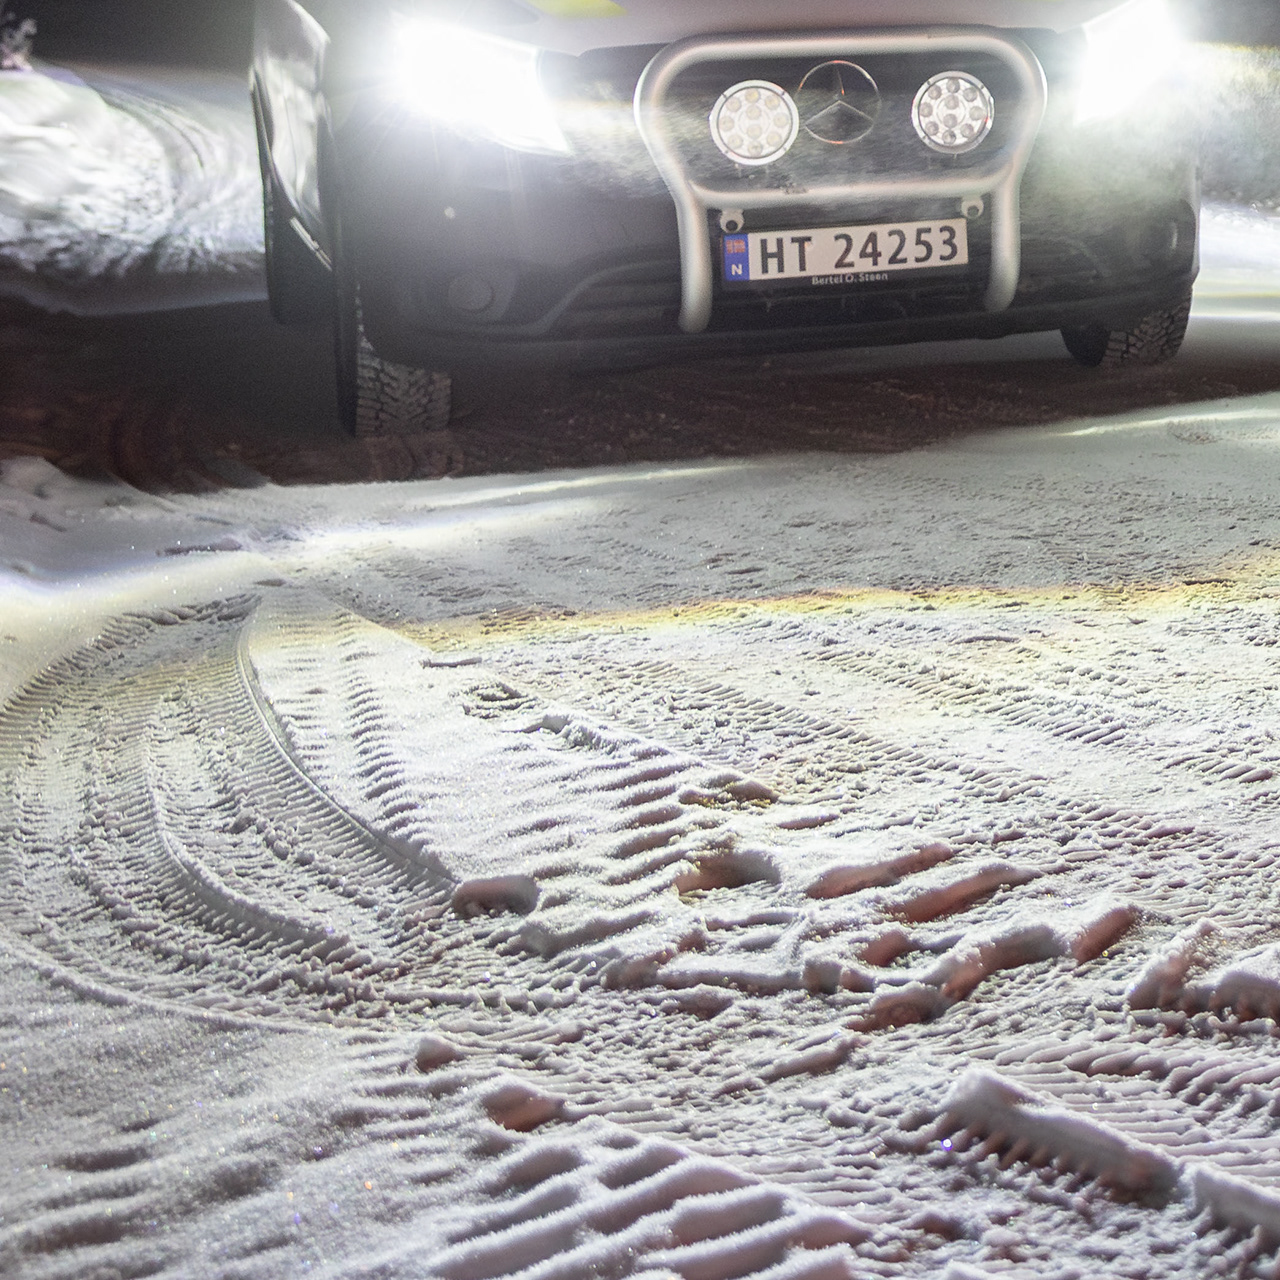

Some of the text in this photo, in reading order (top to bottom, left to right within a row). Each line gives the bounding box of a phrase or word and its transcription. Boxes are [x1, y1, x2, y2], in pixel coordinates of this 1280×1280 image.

[760, 225, 959, 274] HT 24253
[731, 263, 742, 275] N
[811, 274, 843, 285] Bertel
[859, 272, 888, 282] Steen
